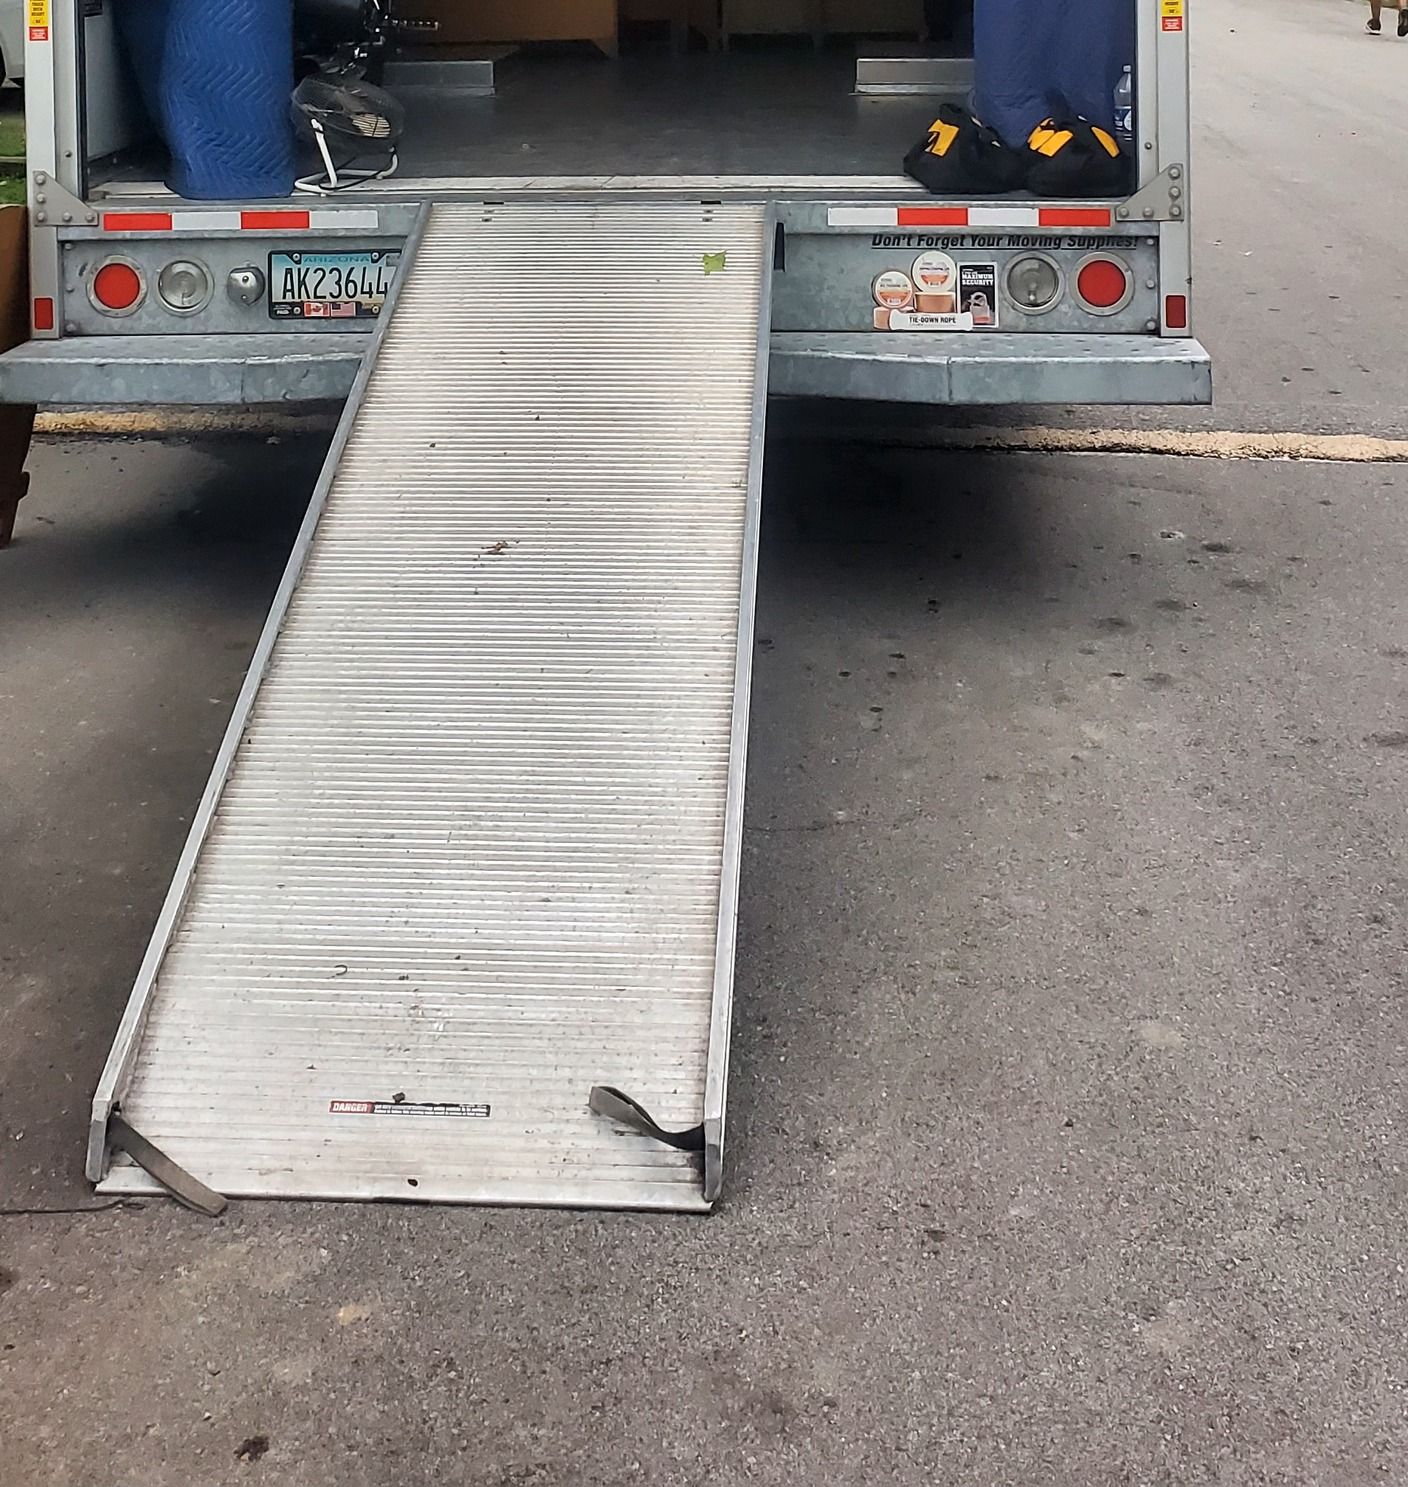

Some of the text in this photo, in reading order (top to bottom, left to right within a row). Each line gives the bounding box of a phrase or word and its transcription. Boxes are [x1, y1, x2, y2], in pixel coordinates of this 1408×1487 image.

[871, 233, 1138, 249] Don't Forget Your Moving Supplies!
[302, 255, 370, 264] ARIZONA
[282, 266, 389, 300] AK23644
[909, 316, 957, 324] TIE-DOWN ROPE
[332, 1102, 369, 1112] DANGER
